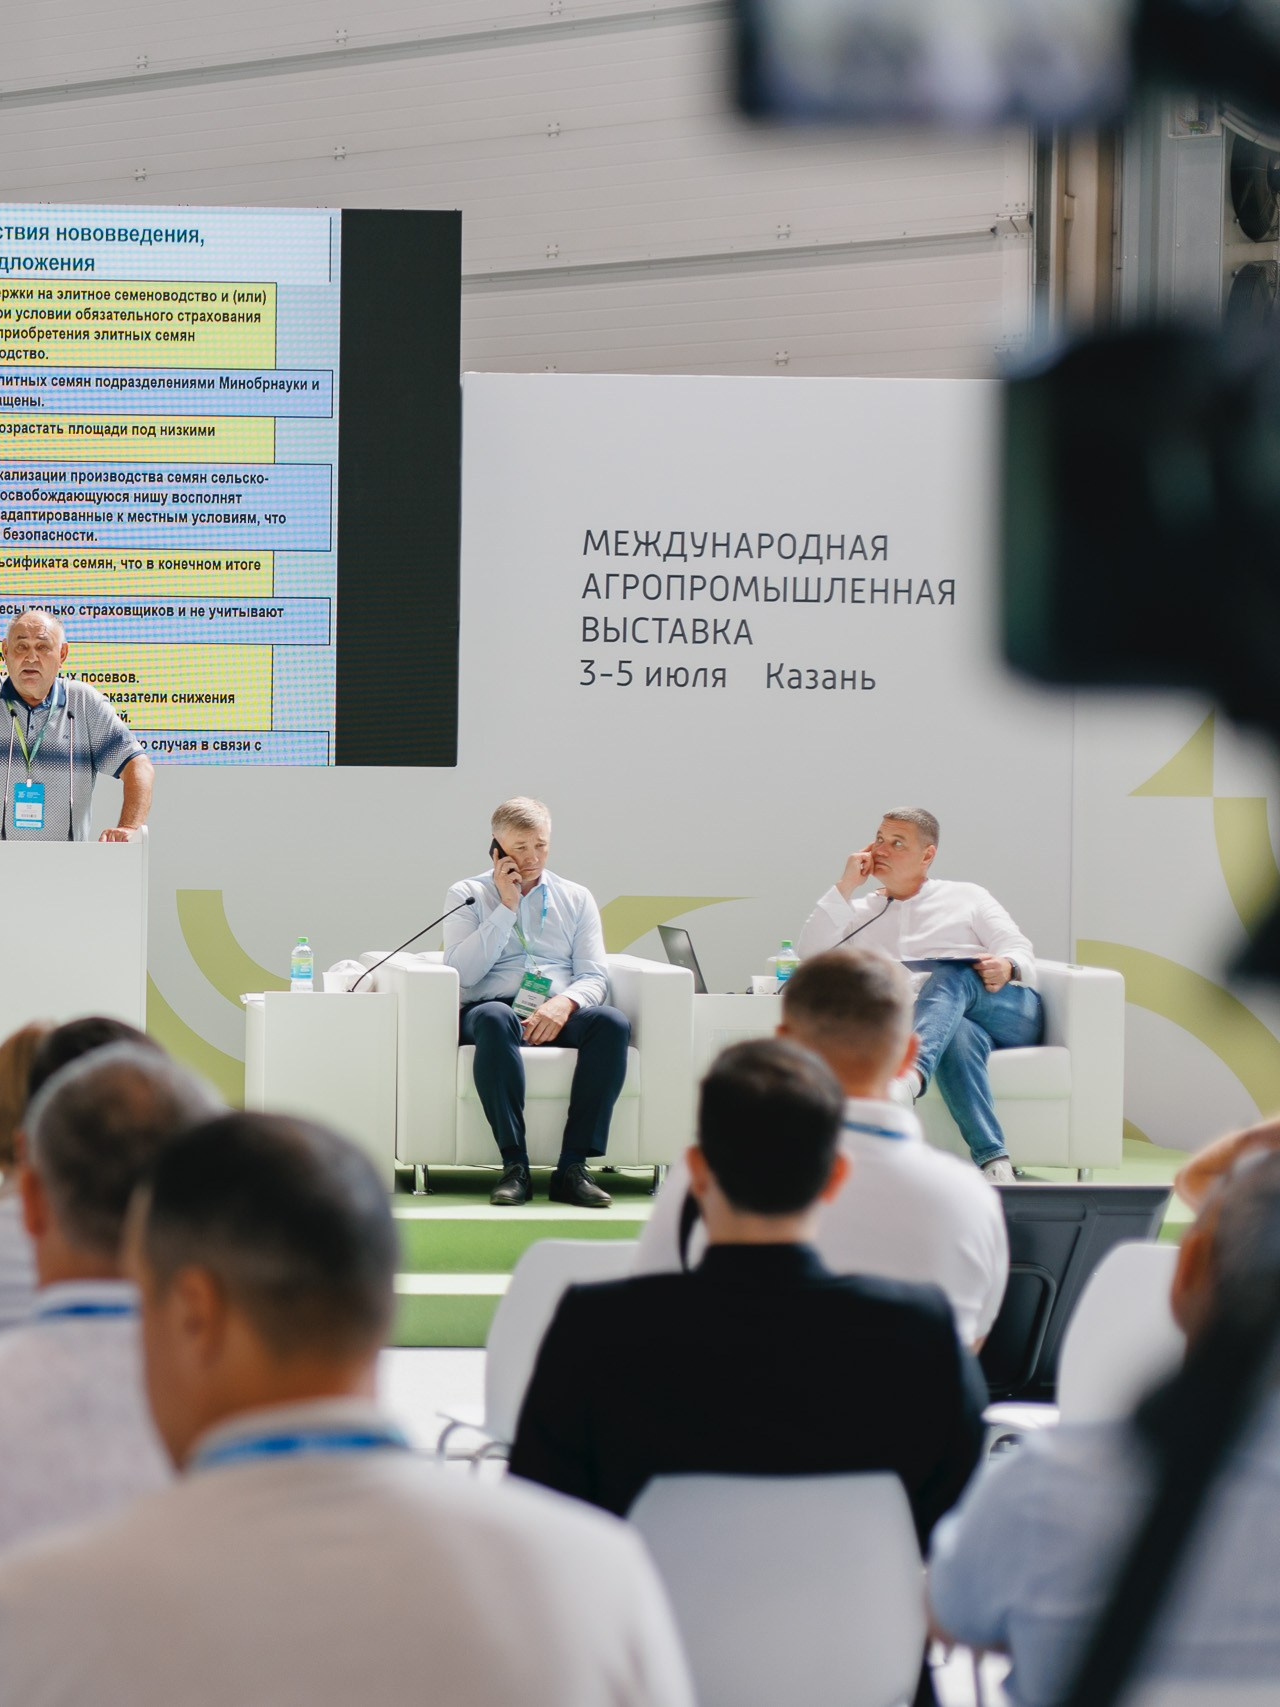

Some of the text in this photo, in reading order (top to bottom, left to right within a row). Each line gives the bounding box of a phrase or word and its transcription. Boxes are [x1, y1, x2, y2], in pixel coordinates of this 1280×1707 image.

[55, 225, 206, 247] нововведения,
[56, 289, 111, 301] элитное
[114, 290, 218, 303] семеноводство
[232, 289, 267, 306] (или)
[14, 308, 72, 323] условии
[74, 307, 174, 322] обязательного
[176, 311, 261, 325] страхования
[93, 329, 152, 341] элитных
[154, 330, 196, 342] семян
[50, 376, 92, 388] семян
[94, 377, 215, 391] подразделениями
[218, 375, 308, 393] Минобрнауки
[67, 424, 128, 437] площади
[131, 424, 157, 438] под
[159, 425, 216, 437] низкими
[70, 471, 164, 485] производства
[166, 472, 208, 484] семян
[210, 473, 269, 485] сельско-
[132, 492, 169, 506] нишу
[170, 492, 243, 504] восполнят
[0, 510, 114, 524] адаптированные
[126, 511, 188, 523] местным
[190, 512, 261, 526] условиям,
[2, 526, 98, 542] безопасности.
[582, 529, 889, 565] МЕЖДУНАРОДНАЯ
[72, 558, 117, 571] семян,
[158, 559, 222, 571] конечном
[224, 559, 262, 571] итоге
[581, 573, 956, 606] АГРОПРОМЫШЛЕННАЯ
[78, 605, 175, 618] страховщиков
[208, 606, 285, 620] учитывают
[581, 616, 754, 645] ВЫСТАВКА
[80, 672, 140, 684] посевов.
[645, 665, 727, 688] июля
[765, 662, 877, 691] Казань
[170, 692, 235, 704] снижения
[150, 739, 198, 753] случая
[212, 740, 251, 752] связи
